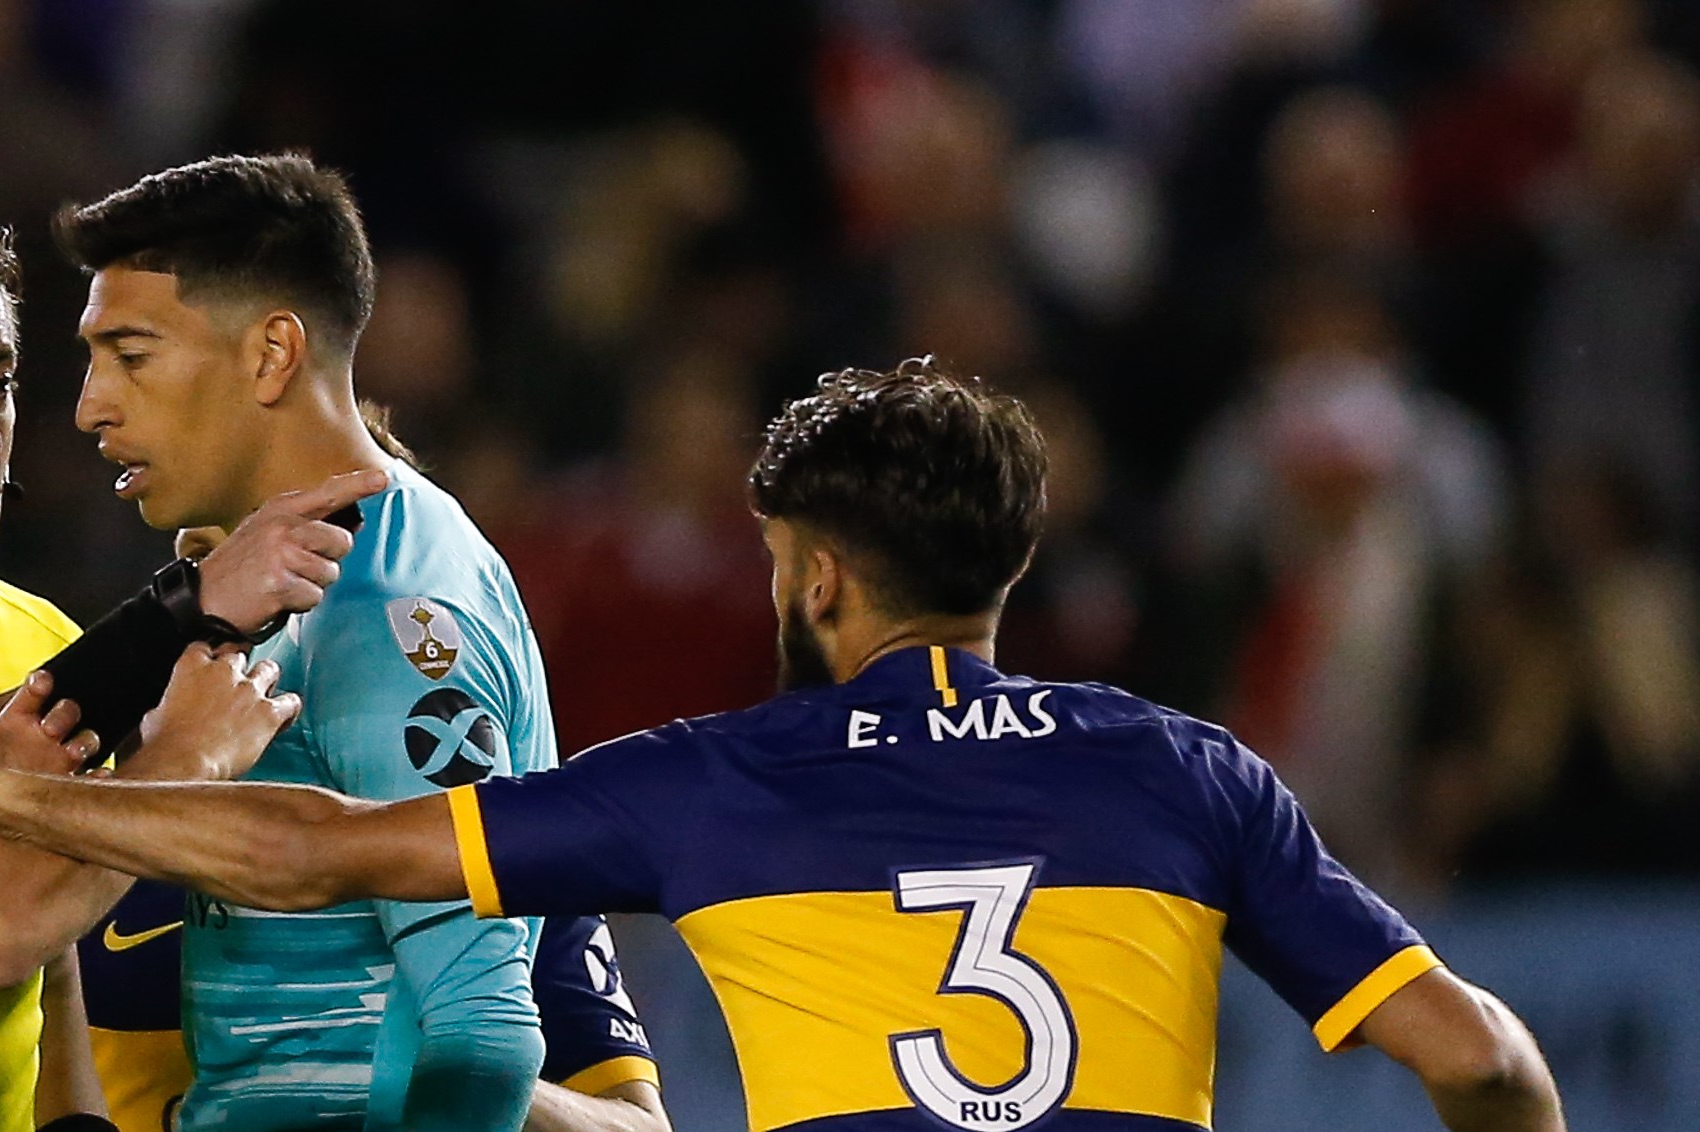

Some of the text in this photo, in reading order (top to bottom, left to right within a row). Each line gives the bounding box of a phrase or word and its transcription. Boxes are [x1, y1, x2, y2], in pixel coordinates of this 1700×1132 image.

[425, 642, 439, 659] 6
[848, 690, 1057, 748] E. MAS
[960, 1102, 1022, 1122] RUS
